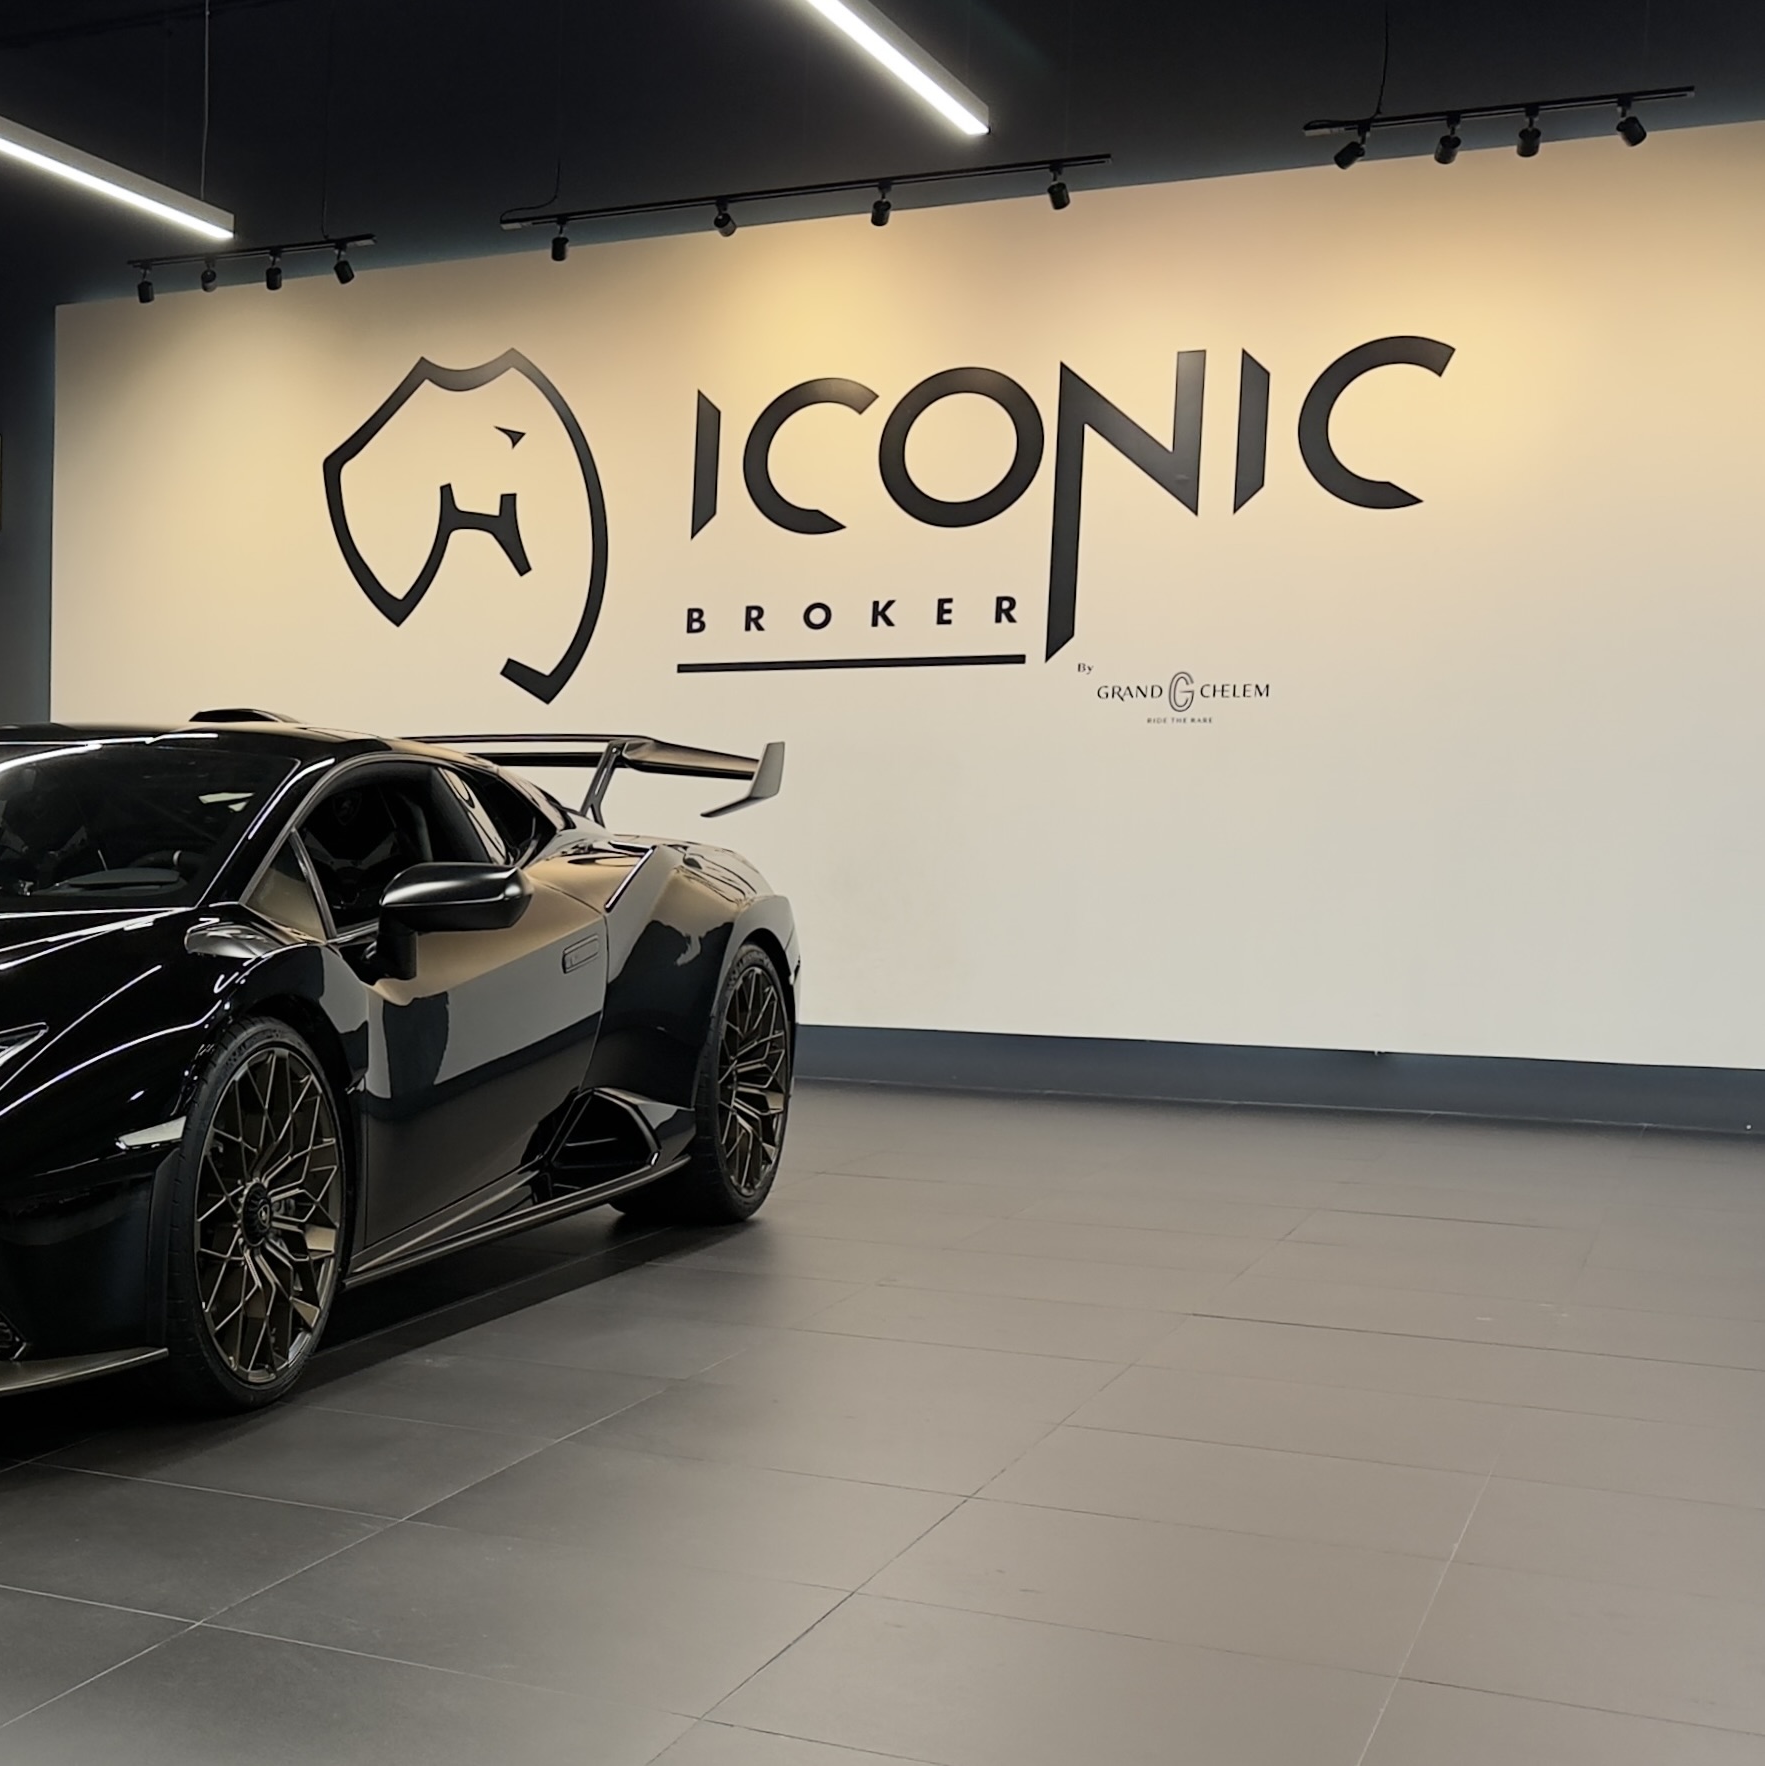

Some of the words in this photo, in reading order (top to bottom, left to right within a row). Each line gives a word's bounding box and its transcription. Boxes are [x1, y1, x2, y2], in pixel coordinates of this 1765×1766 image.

[689, 335, 1456, 663] ICONIC
[686, 595, 1018, 634] BROKER
[1077, 662, 1094, 675] By
[1096, 684, 1164, 702] GRAND
[1199, 683, 1270, 699] CHELEM
